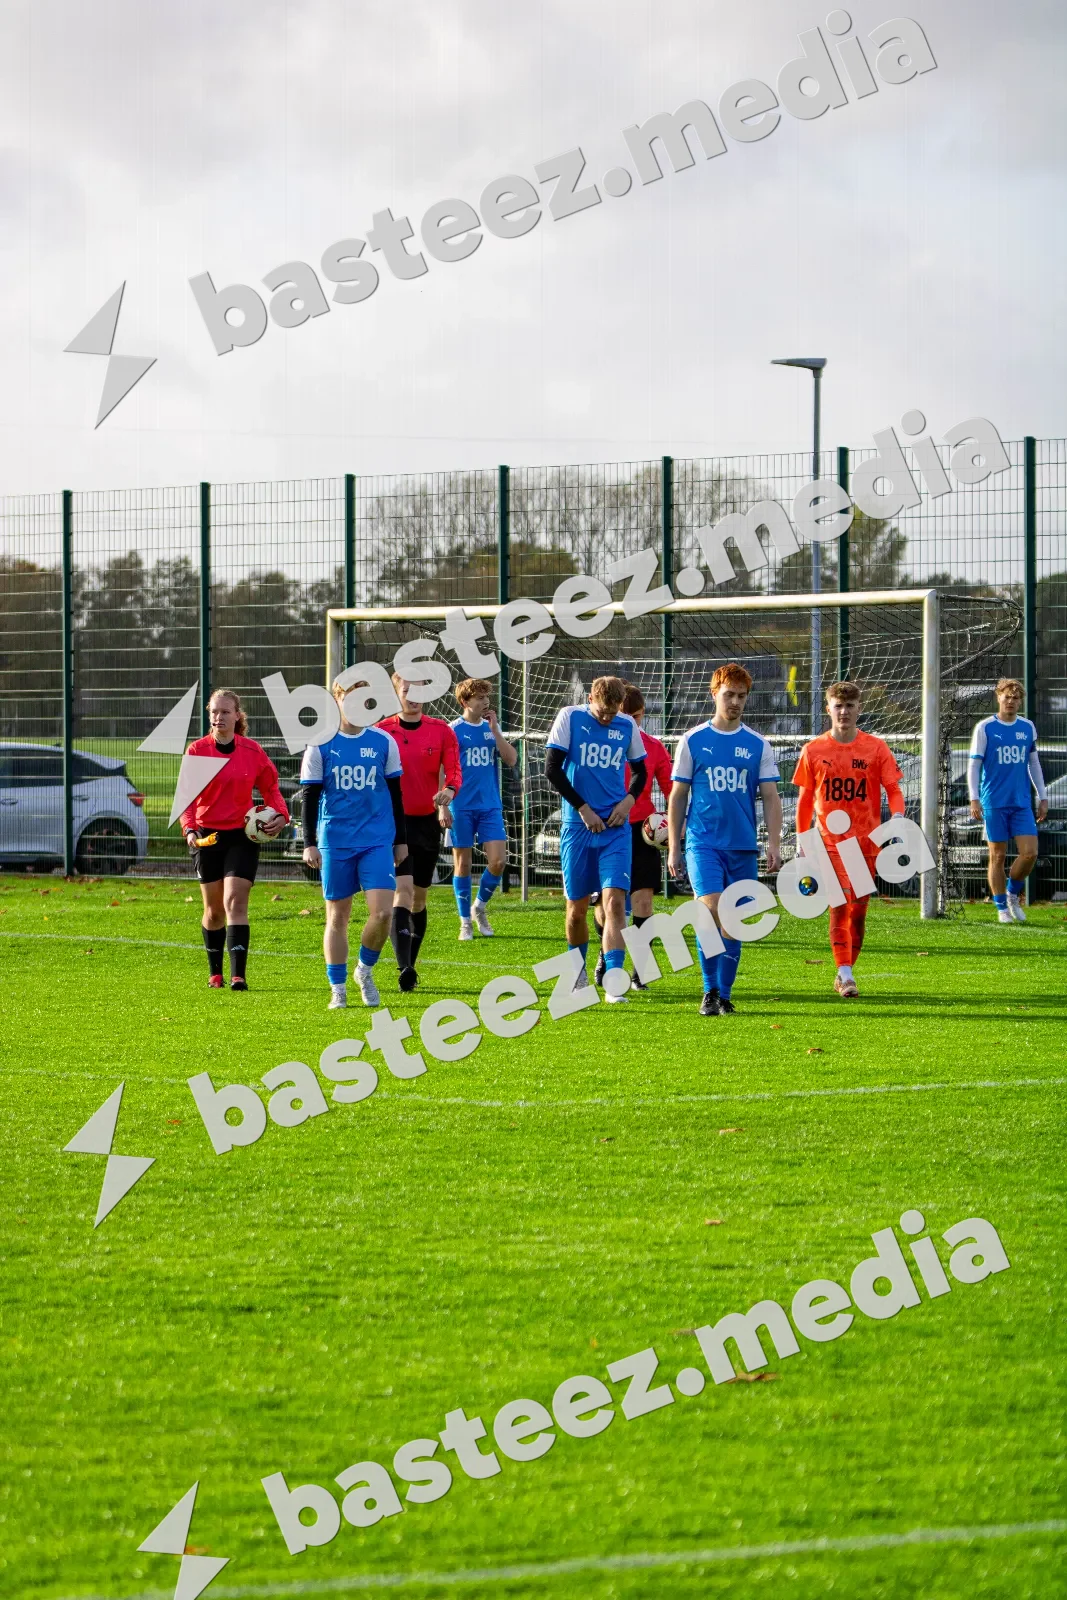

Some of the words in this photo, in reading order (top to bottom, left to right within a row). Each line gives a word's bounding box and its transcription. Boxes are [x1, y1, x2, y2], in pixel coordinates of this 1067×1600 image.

[465, 746, 495, 767] 1894
[579, 742, 624, 771] 1894
[996, 745, 1026, 765] 1894
[331, 765, 377, 791] 1894
[705, 765, 748, 794] 1894
[823, 777, 868, 802] 1894
